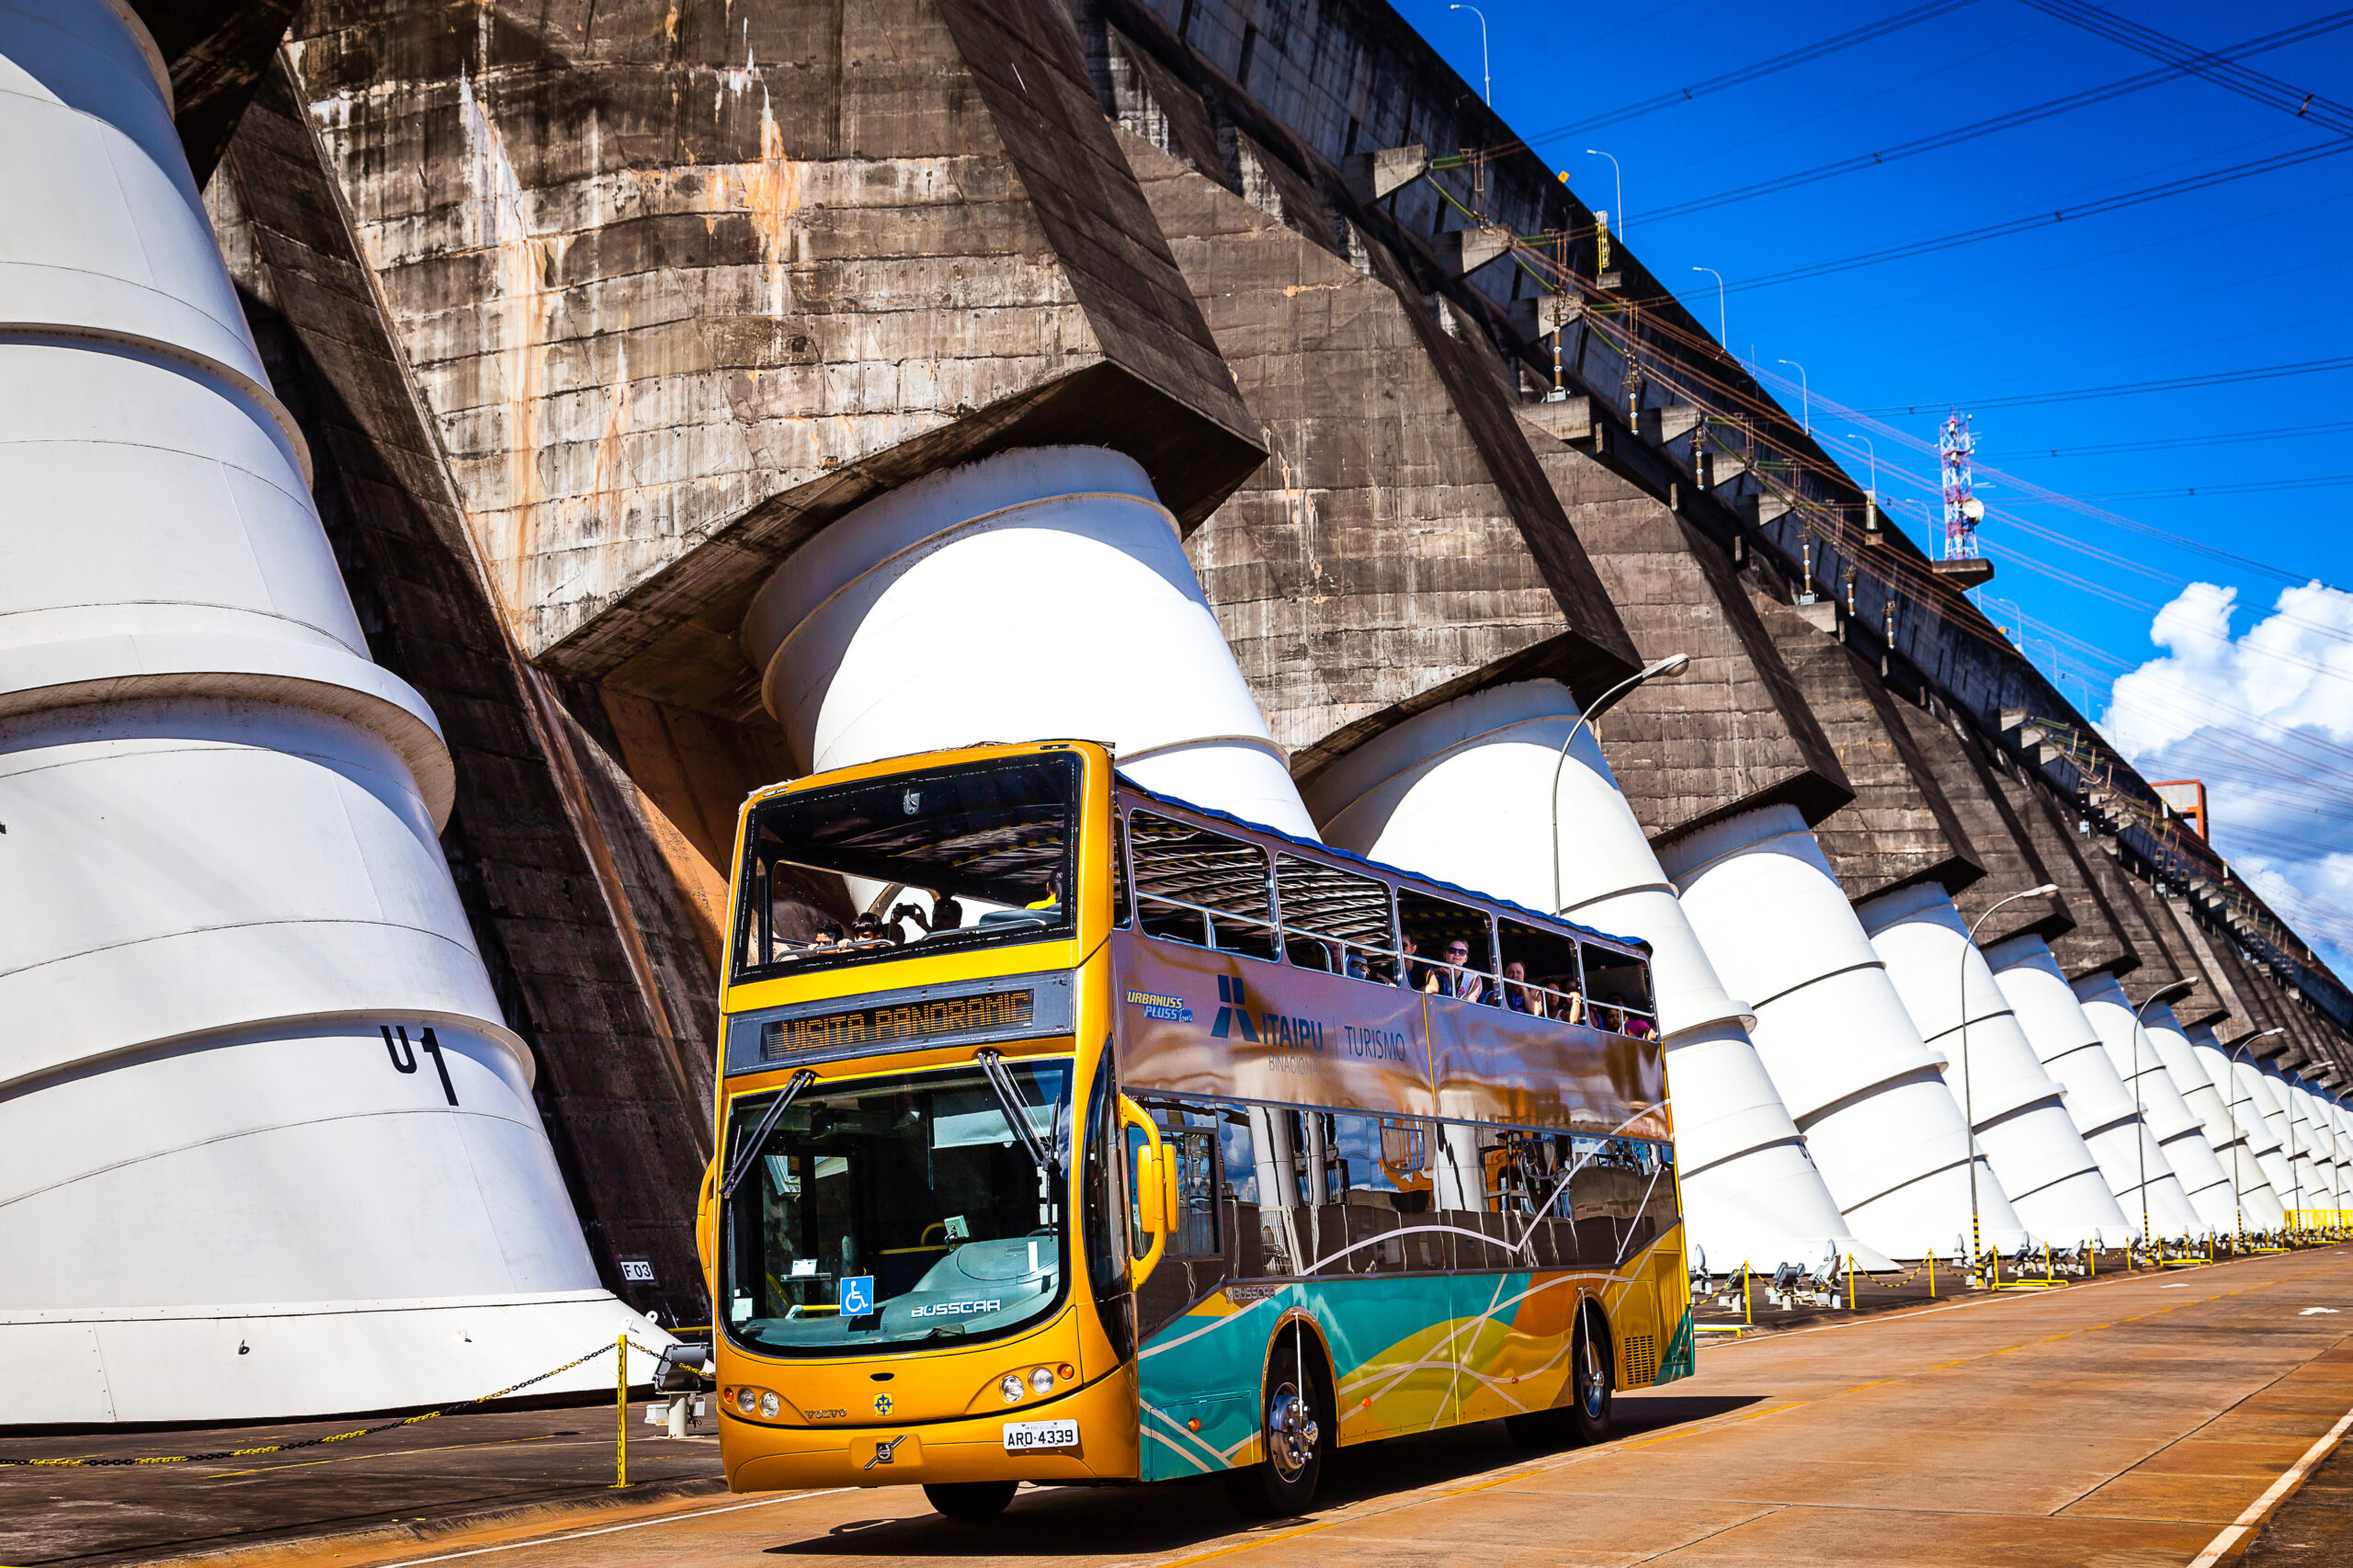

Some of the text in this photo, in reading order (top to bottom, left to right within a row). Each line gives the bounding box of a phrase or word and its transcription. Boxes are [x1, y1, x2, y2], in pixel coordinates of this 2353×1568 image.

[1127, 991, 1183, 1008] URBANUSS
[1144, 1005, 1178, 1020] PLUSS
[782, 1014, 865, 1051] VISITA
[1261, 1012, 1406, 1062] ITAIPU TURISMO
[1268, 1053, 1323, 1079] BINACIONAL
[623, 1264, 651, 1278] F 03
[911, 1299, 1001, 1318] BUSSCAR
[804, 1408, 847, 1419] VOLVO
